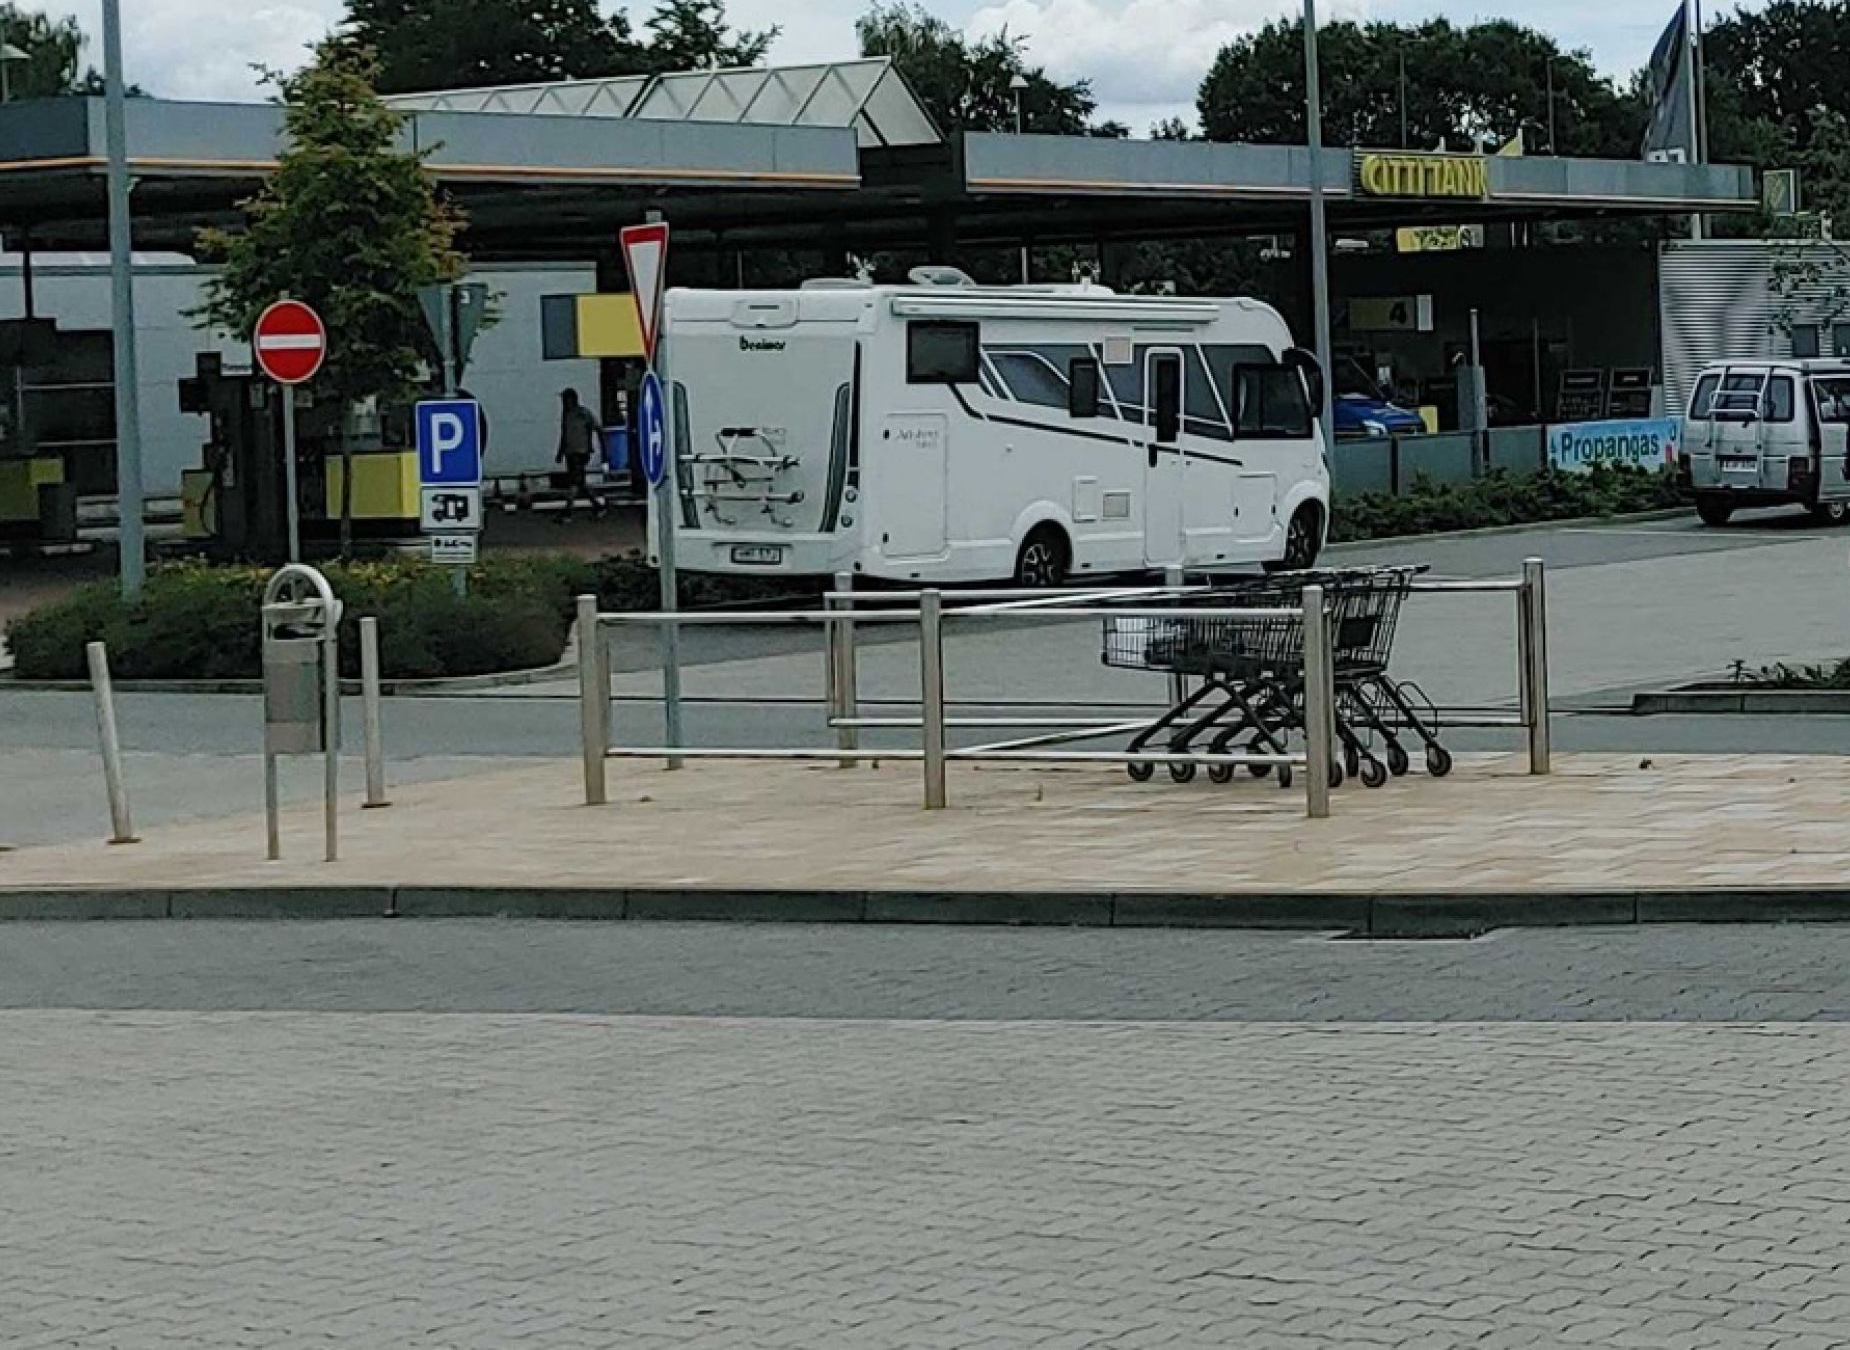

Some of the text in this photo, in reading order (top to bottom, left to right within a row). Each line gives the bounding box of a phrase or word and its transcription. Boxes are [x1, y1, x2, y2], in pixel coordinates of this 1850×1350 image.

[1388, 301, 1407, 325] 4
[431, 412, 464, 475] P
[1560, 430, 1661, 464] Propangas
